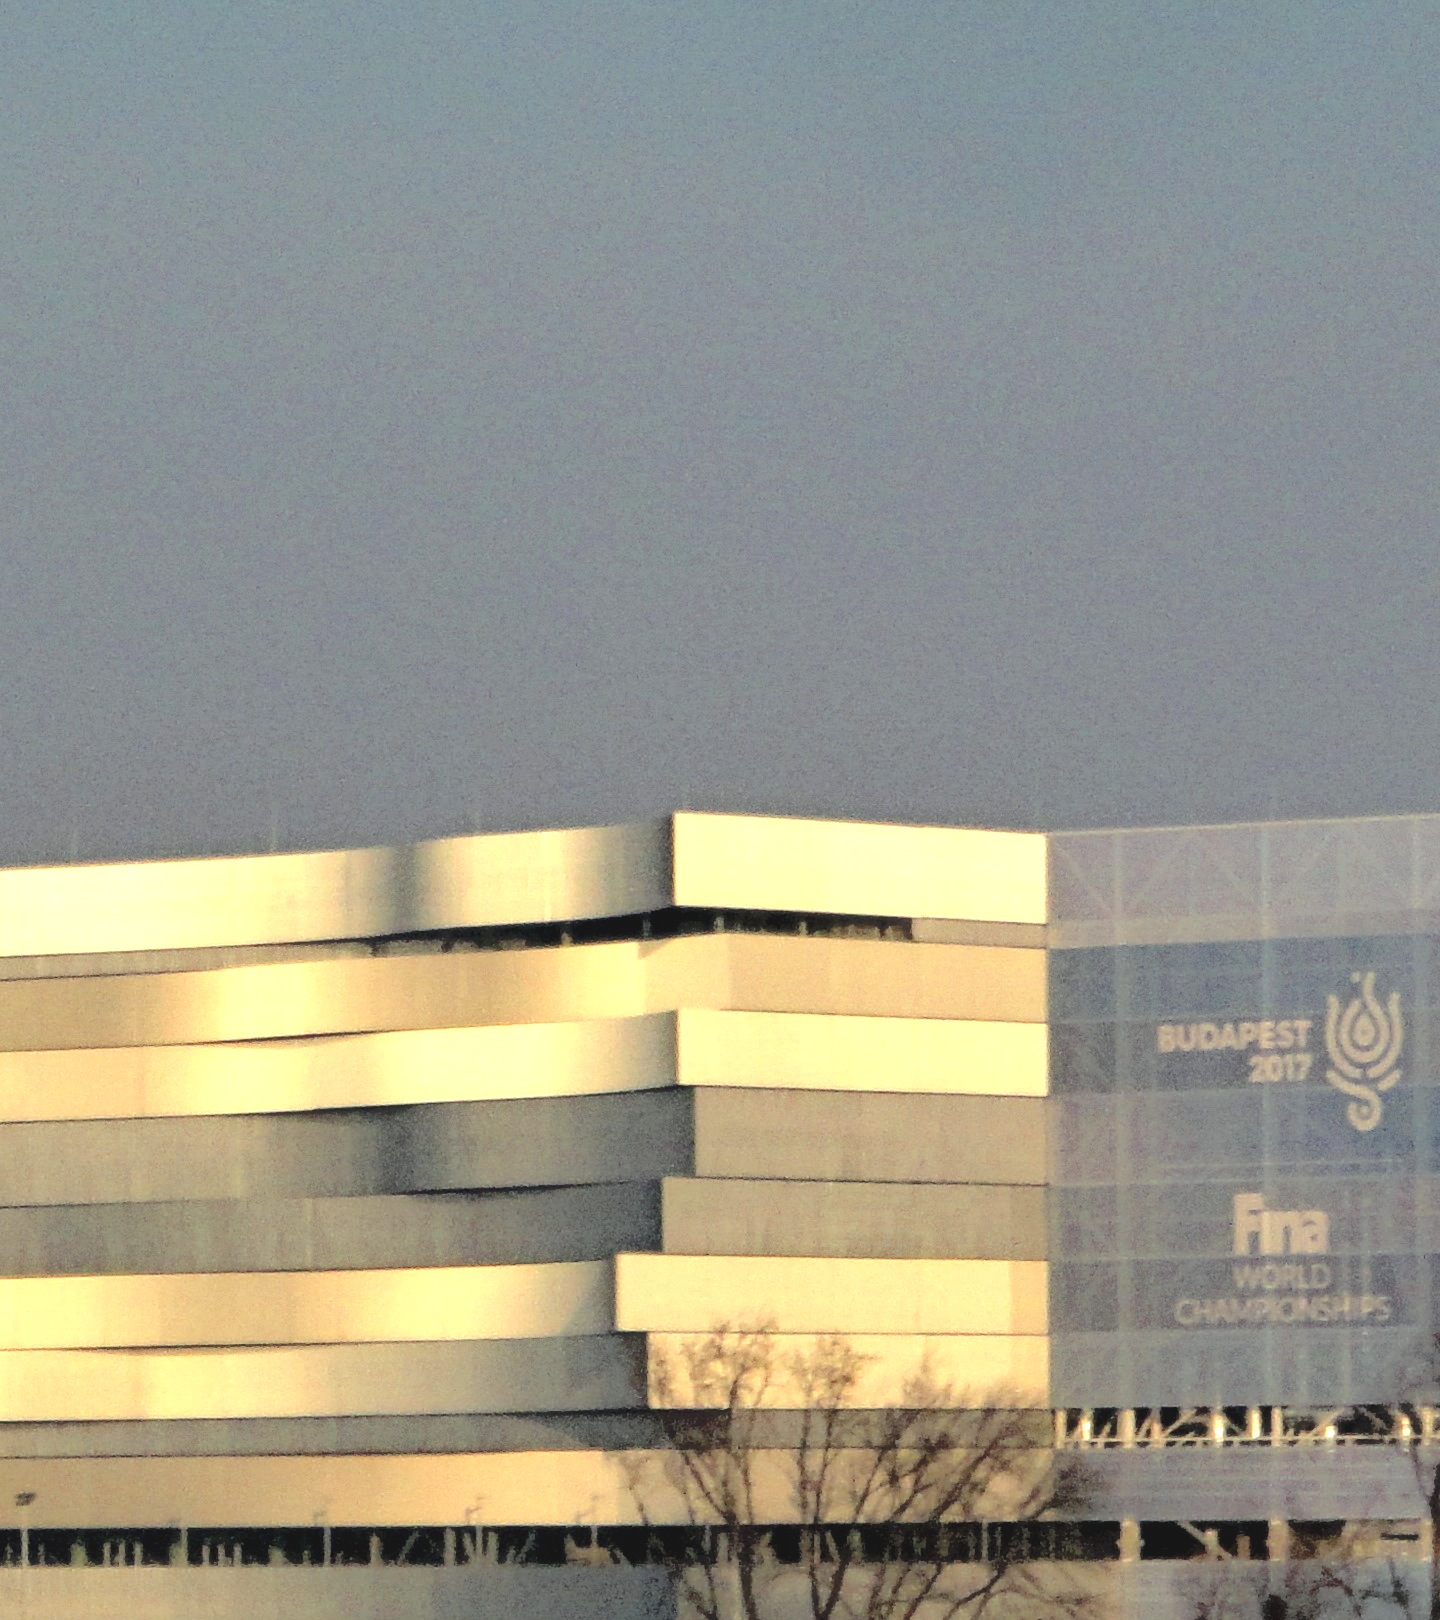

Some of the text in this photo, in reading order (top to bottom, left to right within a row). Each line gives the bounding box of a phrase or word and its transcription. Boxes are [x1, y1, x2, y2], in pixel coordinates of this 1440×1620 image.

[1157, 1020, 1310, 1053] BUDAPEST
[1248, 1053, 1312, 1083] 2017
[1232, 1263, 1331, 1290] WORLD
[1174, 1293, 1395, 1326] CHAMPIONSHIPS
